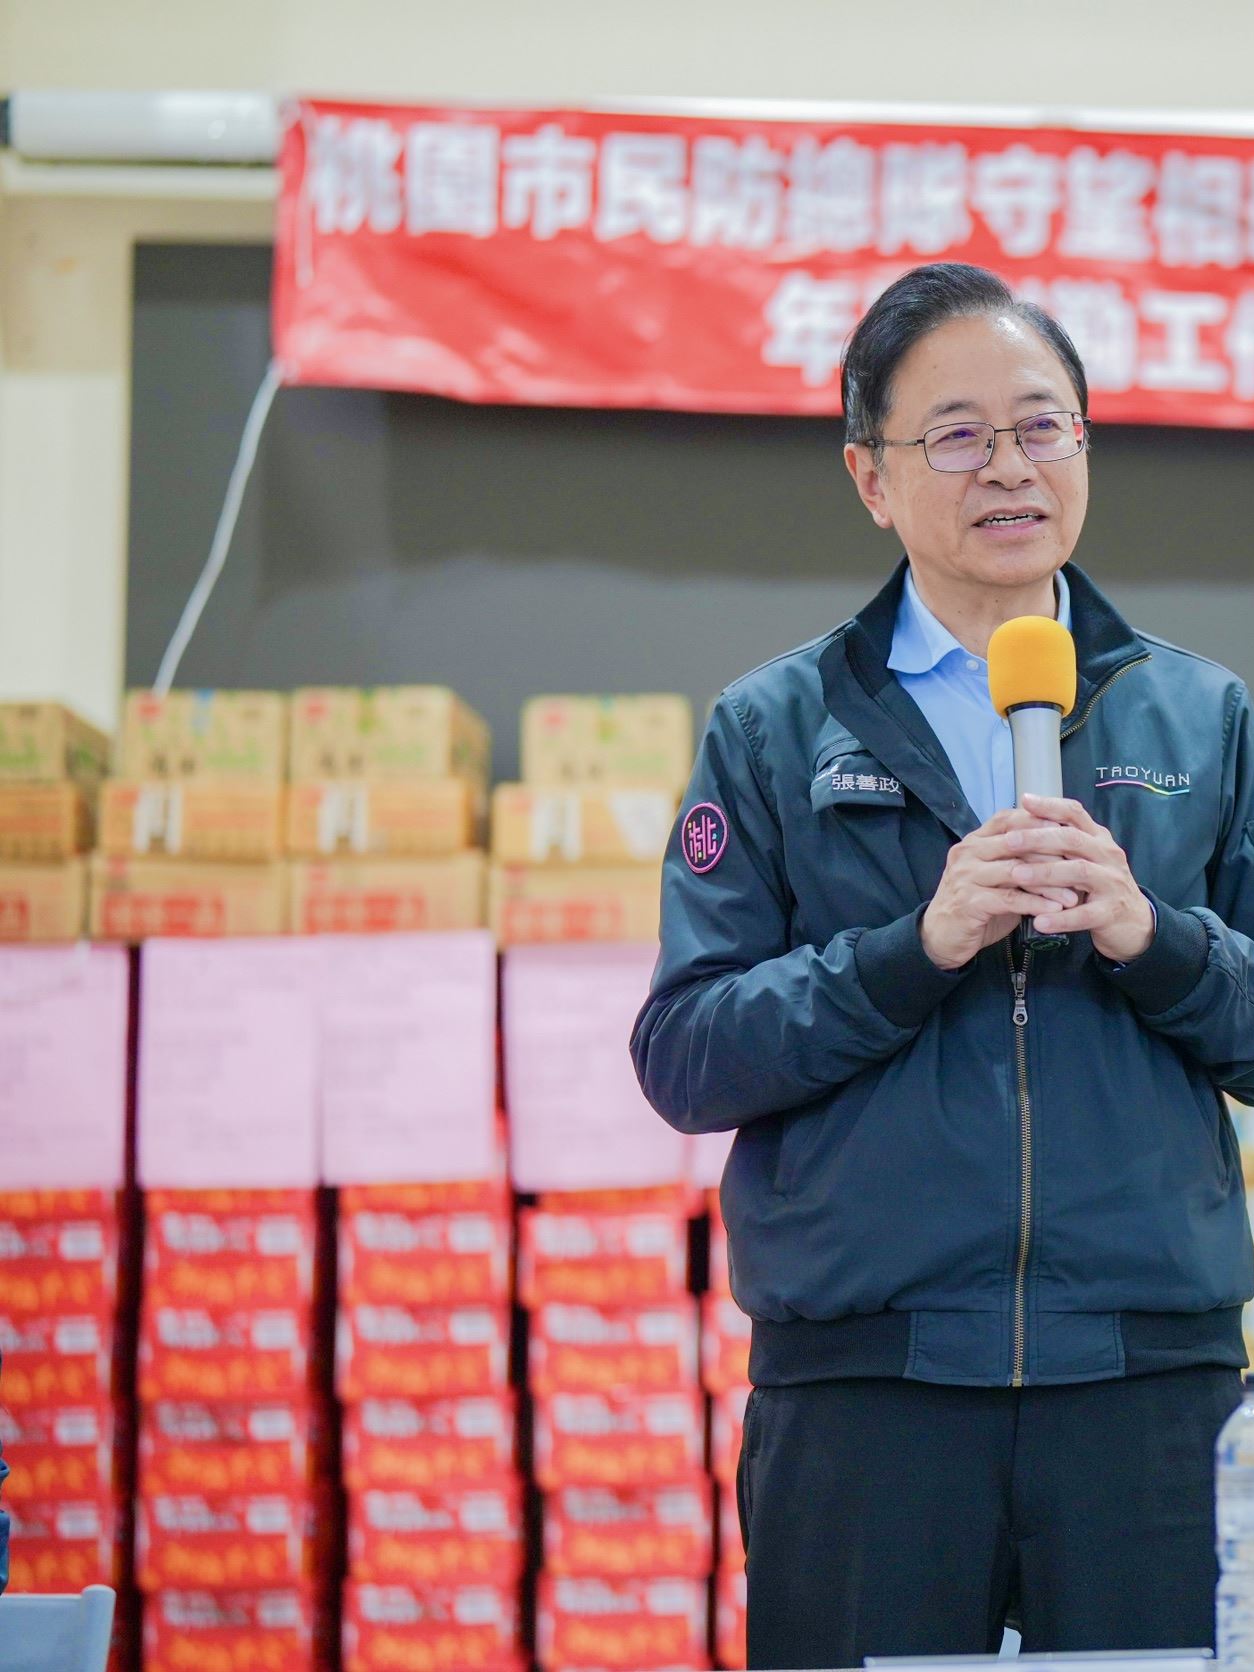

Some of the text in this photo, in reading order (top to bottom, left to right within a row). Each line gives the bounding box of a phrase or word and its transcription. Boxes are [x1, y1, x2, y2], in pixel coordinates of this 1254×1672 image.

[831, 773, 902, 794] 張善政
[1095, 766, 1190, 787] TAOYUAN
